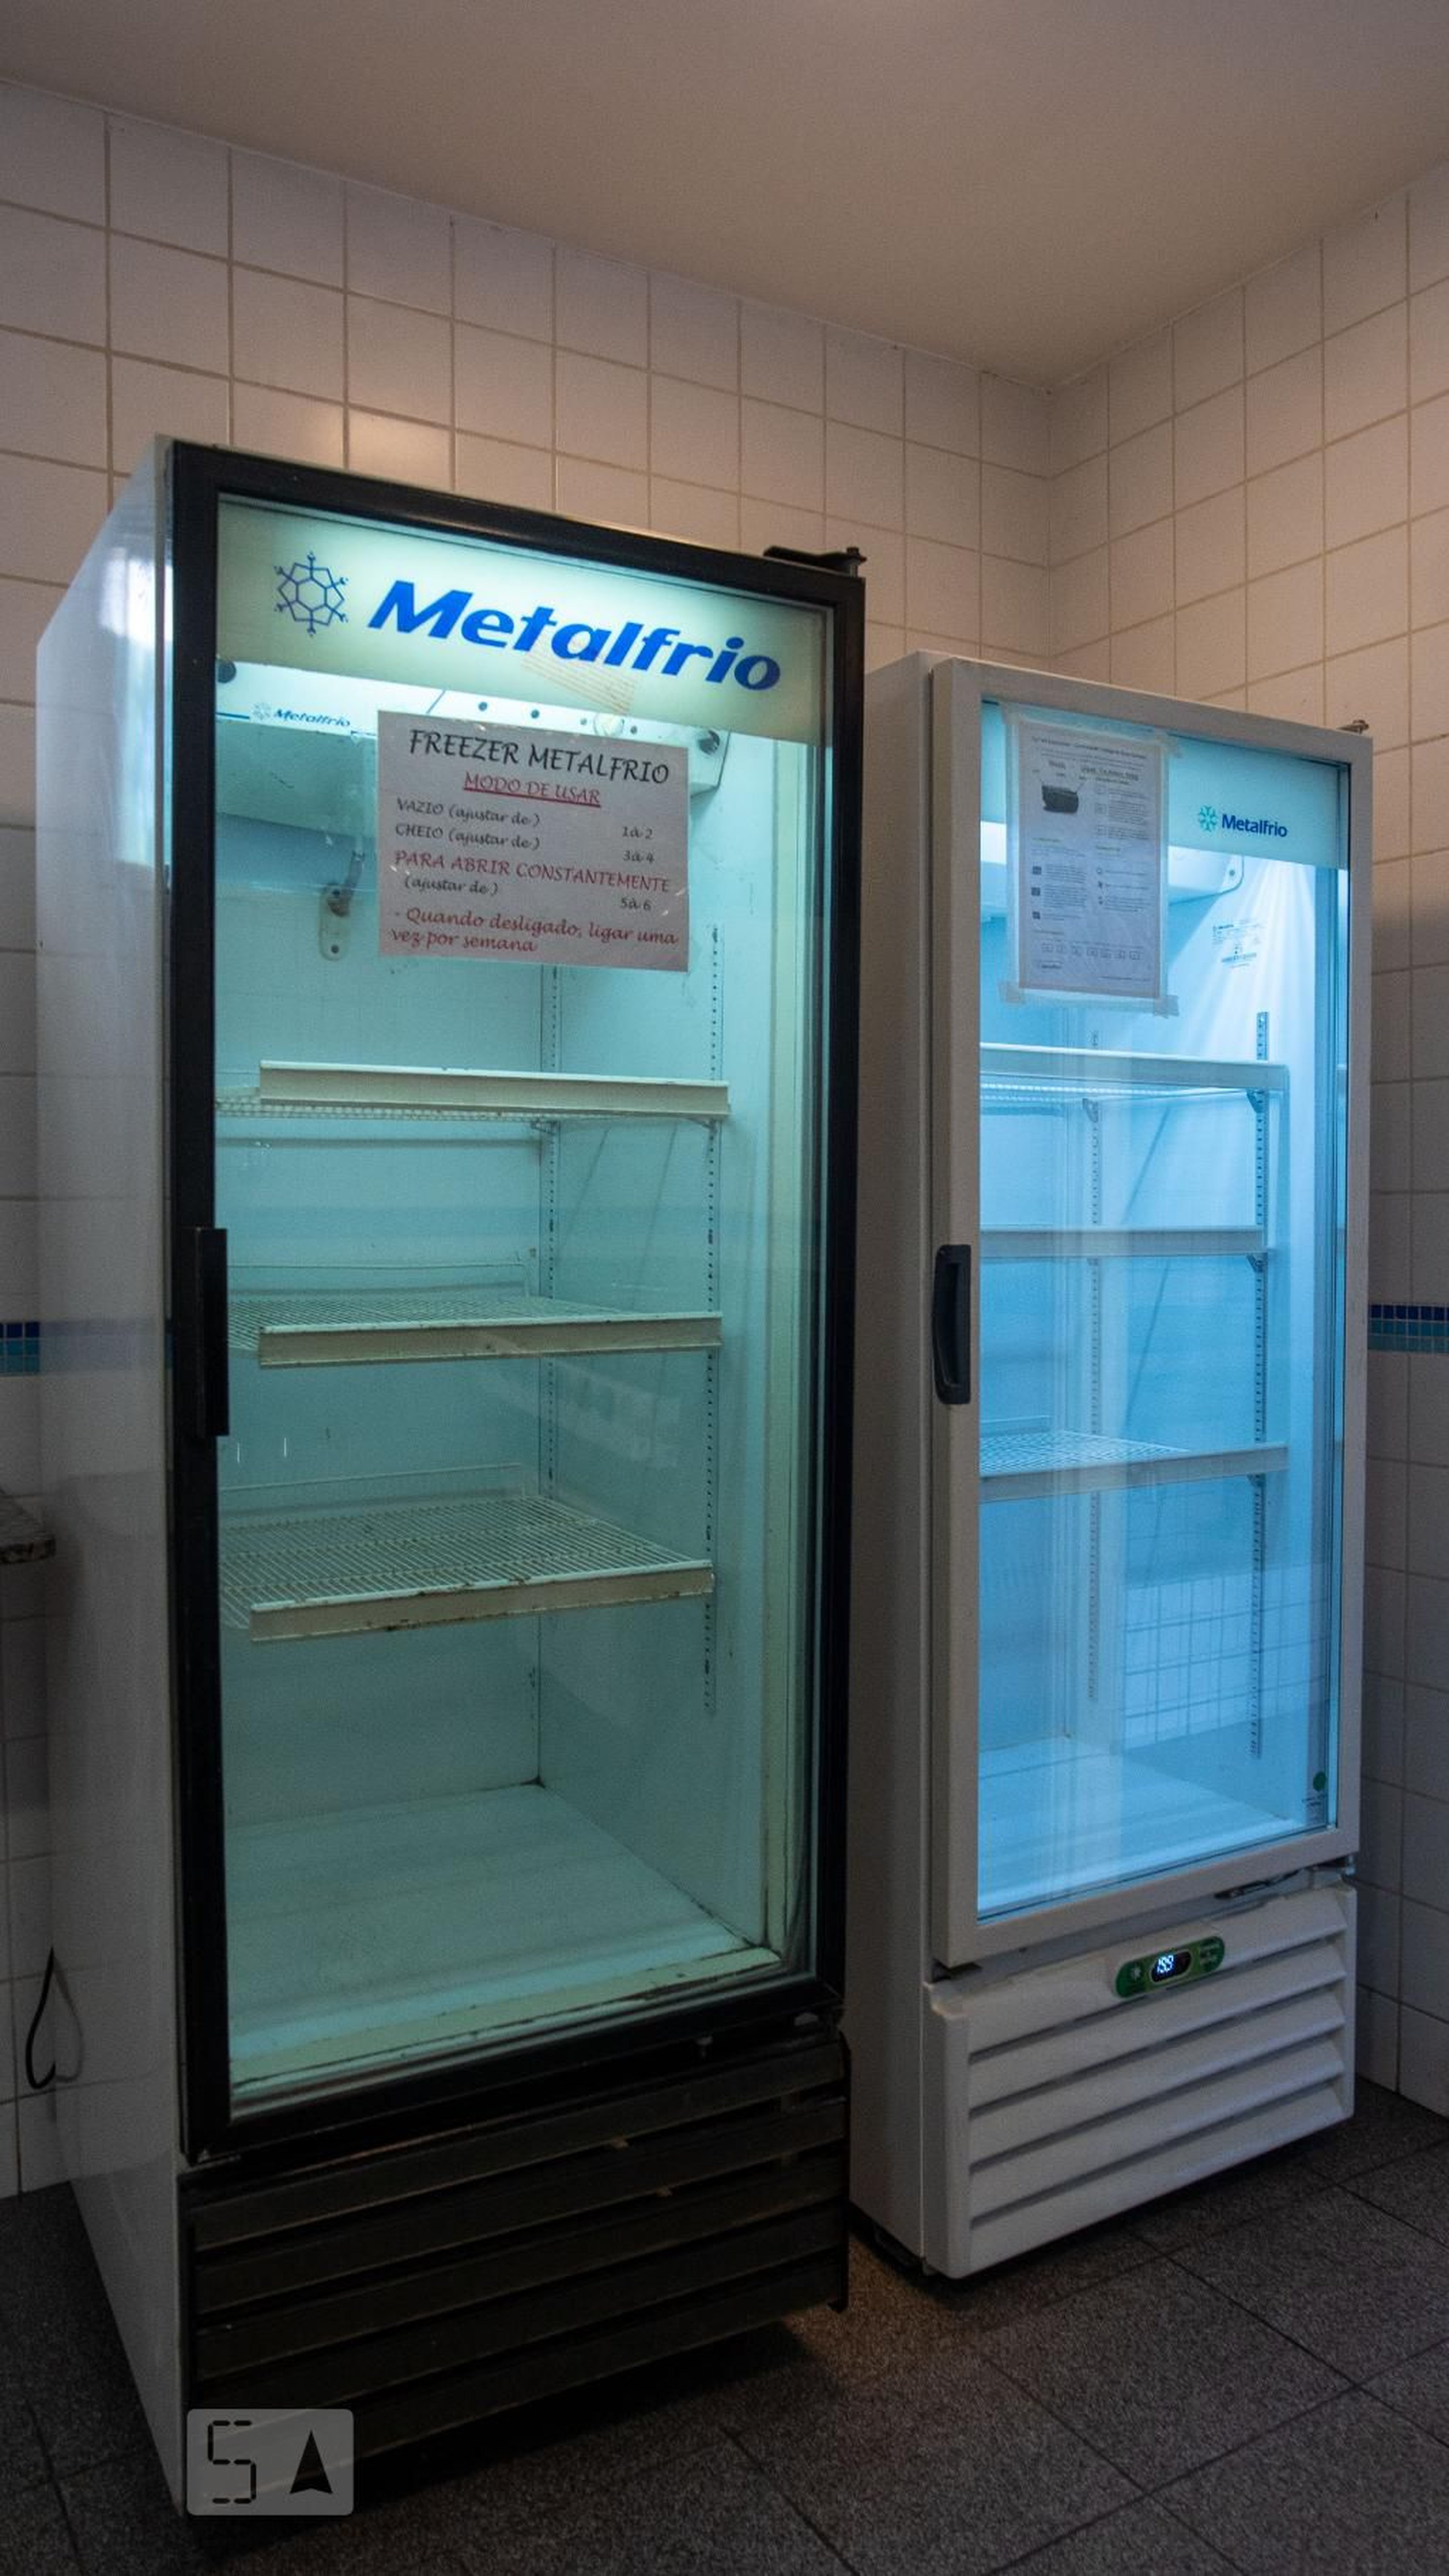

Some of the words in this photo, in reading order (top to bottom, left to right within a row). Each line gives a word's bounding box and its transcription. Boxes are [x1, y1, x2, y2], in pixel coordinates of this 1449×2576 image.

[368, 580, 780, 691] Metalfrio
[274, 709, 350, 727] Metalfrio
[410, 729, 519, 764] FREEZER
[528, 744, 669, 784] METALFRIO
[464, 770, 520, 793] MODO
[528, 781, 550, 796] DE
[555, 784, 601, 804] USAR
[397, 797, 444, 815] VAZIO
[395, 823, 444, 839] CHEIO
[1222, 814, 1288, 838] Metalfrio
[395, 850, 445, 869] PARA
[451, 856, 510, 875] ABRIR
[515, 862, 670, 893] CONSTANTEMENTE
[391, 928, 421, 948] vez
[427, 931, 460, 950] por
[463, 935, 538, 952] semana
[406, 907, 485, 927] Quando
[589, 922, 632, 943] ligar
[637, 932, 679, 945] uma
